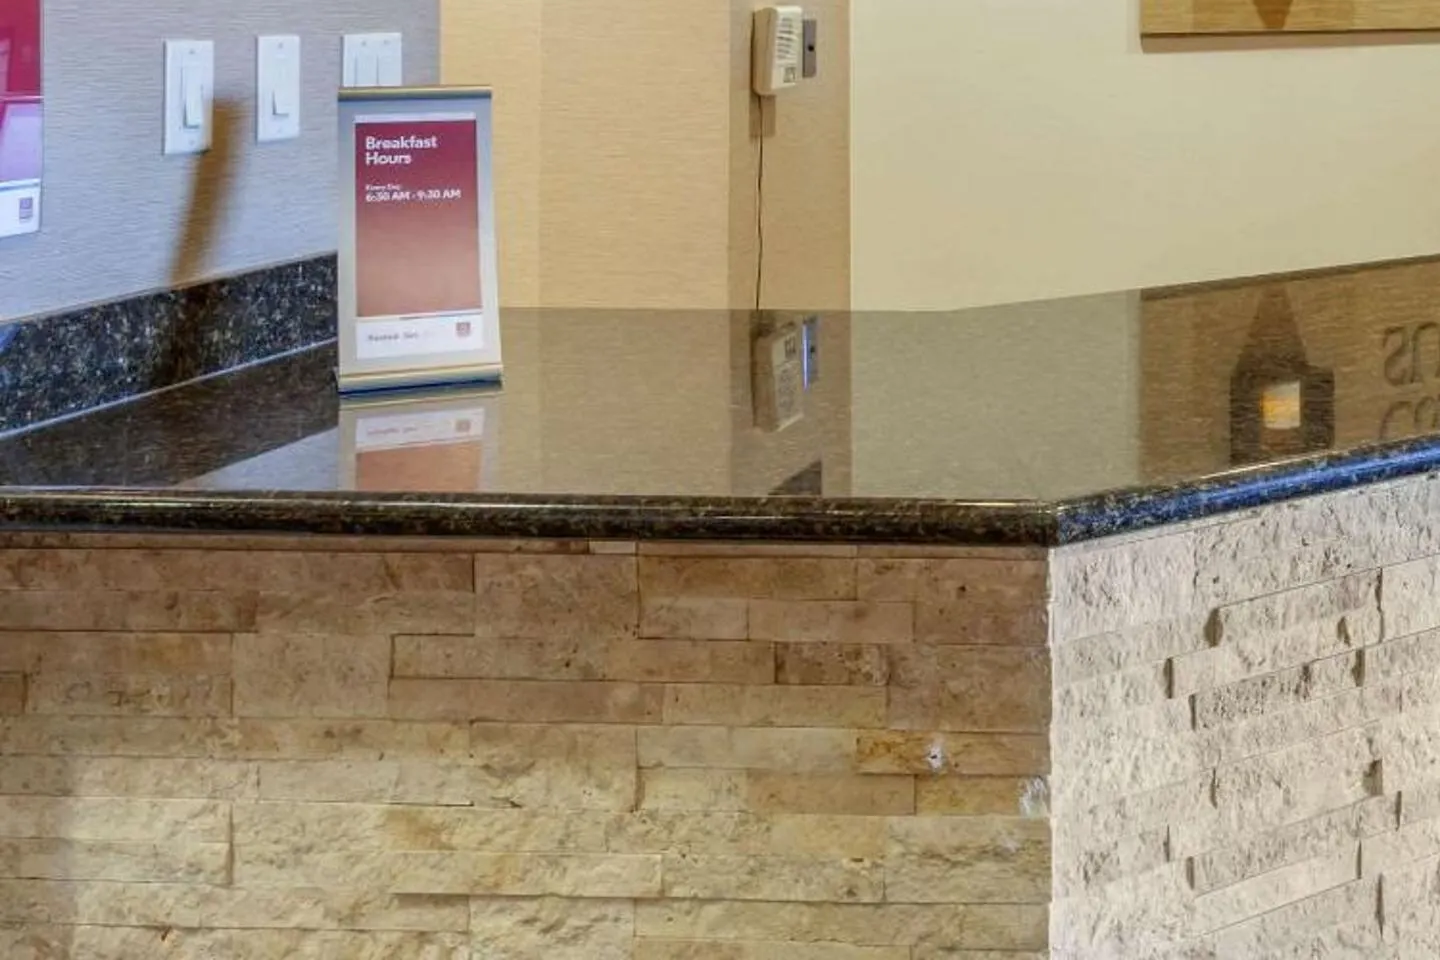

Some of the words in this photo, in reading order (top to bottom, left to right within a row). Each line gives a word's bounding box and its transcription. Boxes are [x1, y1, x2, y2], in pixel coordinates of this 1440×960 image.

[365, 135, 439, 150] Breakfast
[365, 151, 413, 166] Hours
[391, 190, 411, 201] AM
[443, 188, 463, 199] AM
